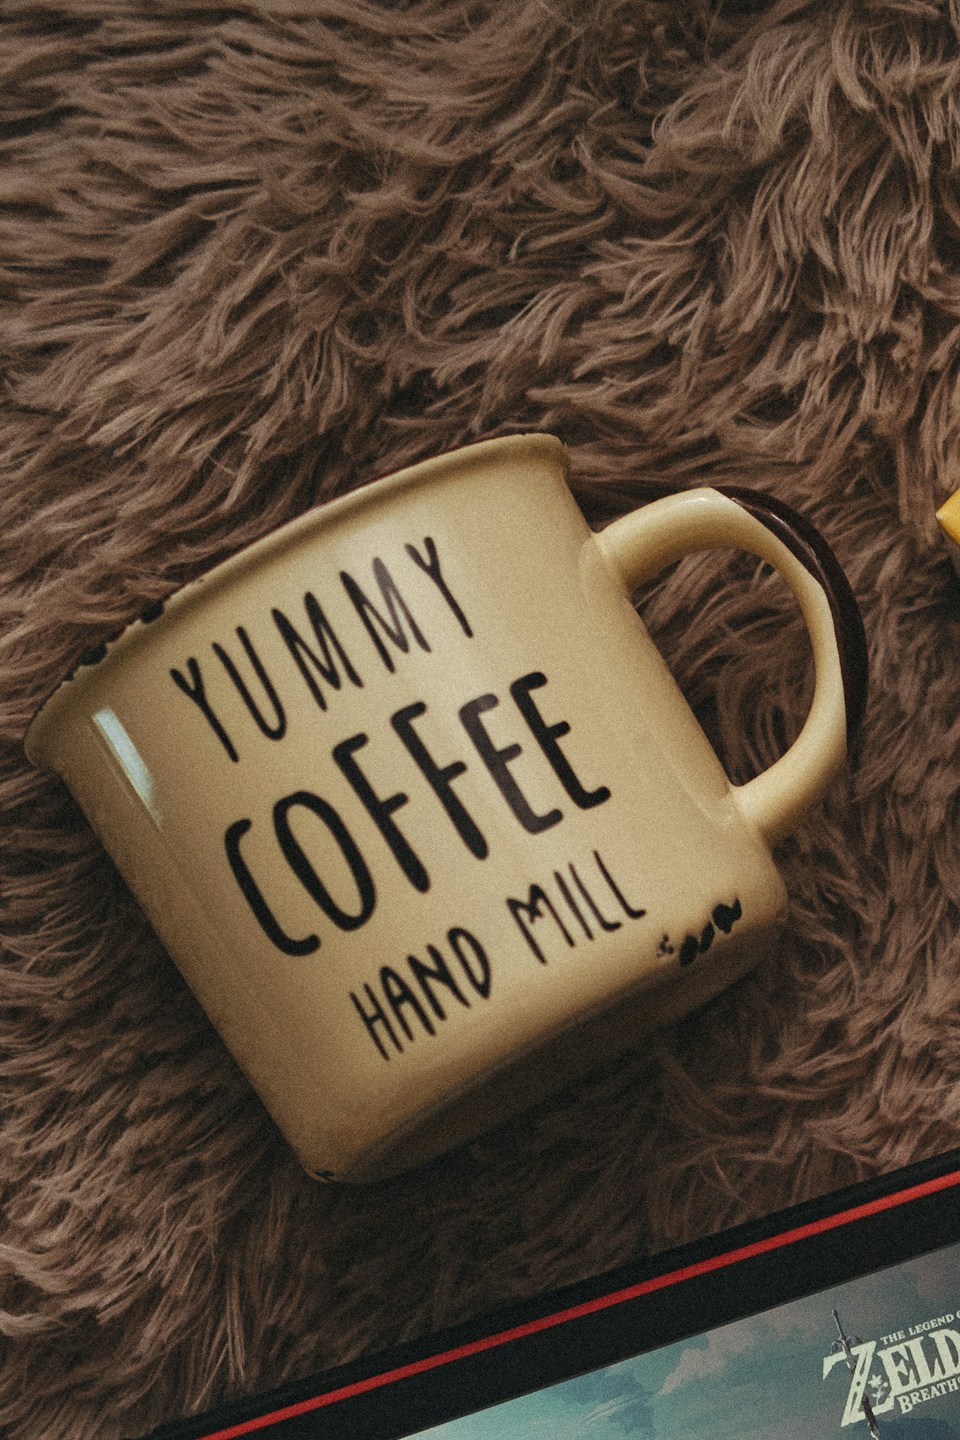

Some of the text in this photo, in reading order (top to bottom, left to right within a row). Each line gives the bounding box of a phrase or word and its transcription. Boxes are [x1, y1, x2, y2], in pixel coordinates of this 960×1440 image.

[169, 536, 475, 763] YUMMY
[223, 670, 612, 958] COFFEE
[349, 850, 646, 1062] HAND MILL
[880, 1331, 906, 1345] THE
[908, 1314, 954, 1336] LEGEND
[896, 1378, 960, 1414] BREATH
